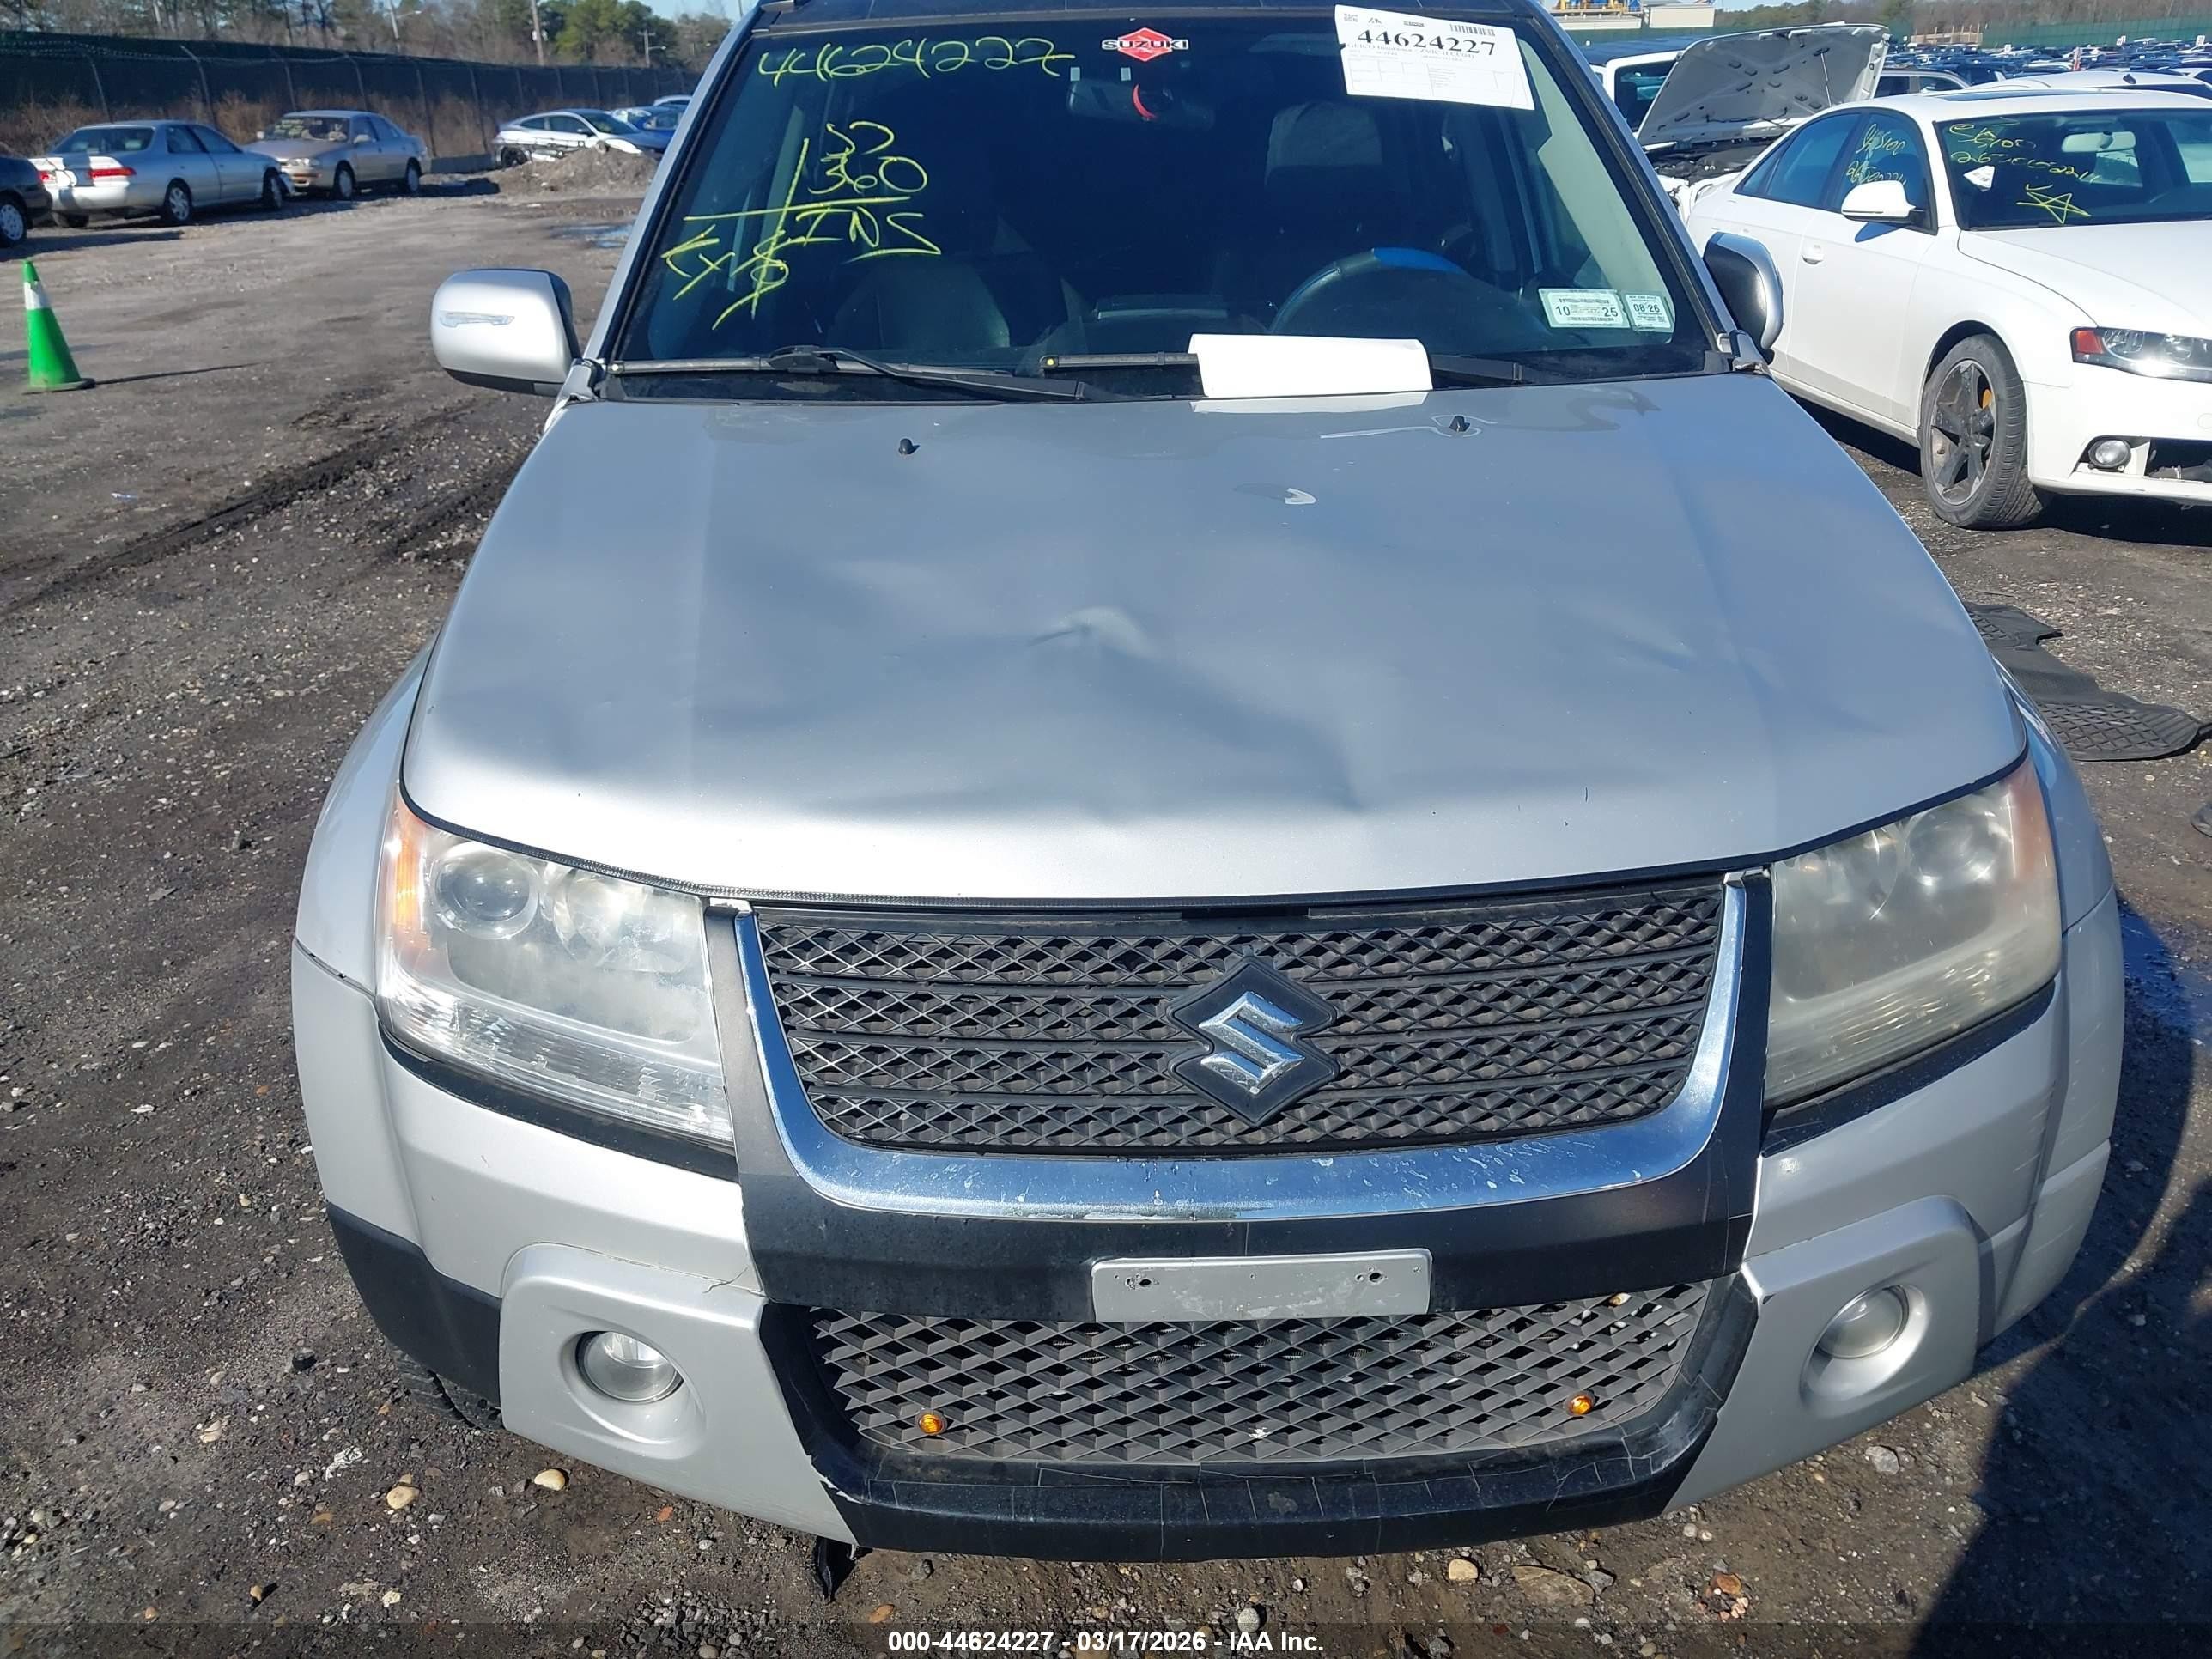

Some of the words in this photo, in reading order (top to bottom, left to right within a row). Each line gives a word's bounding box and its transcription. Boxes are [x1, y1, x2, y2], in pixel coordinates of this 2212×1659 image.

[1102, 39, 1188, 50] SUZUKI
[1358, 29, 1496, 57] 44624227
[1556, 306, 1571, 316] 10
[1602, 307, 1618, 317] 25
[1648, 304, 1660, 313] 26
